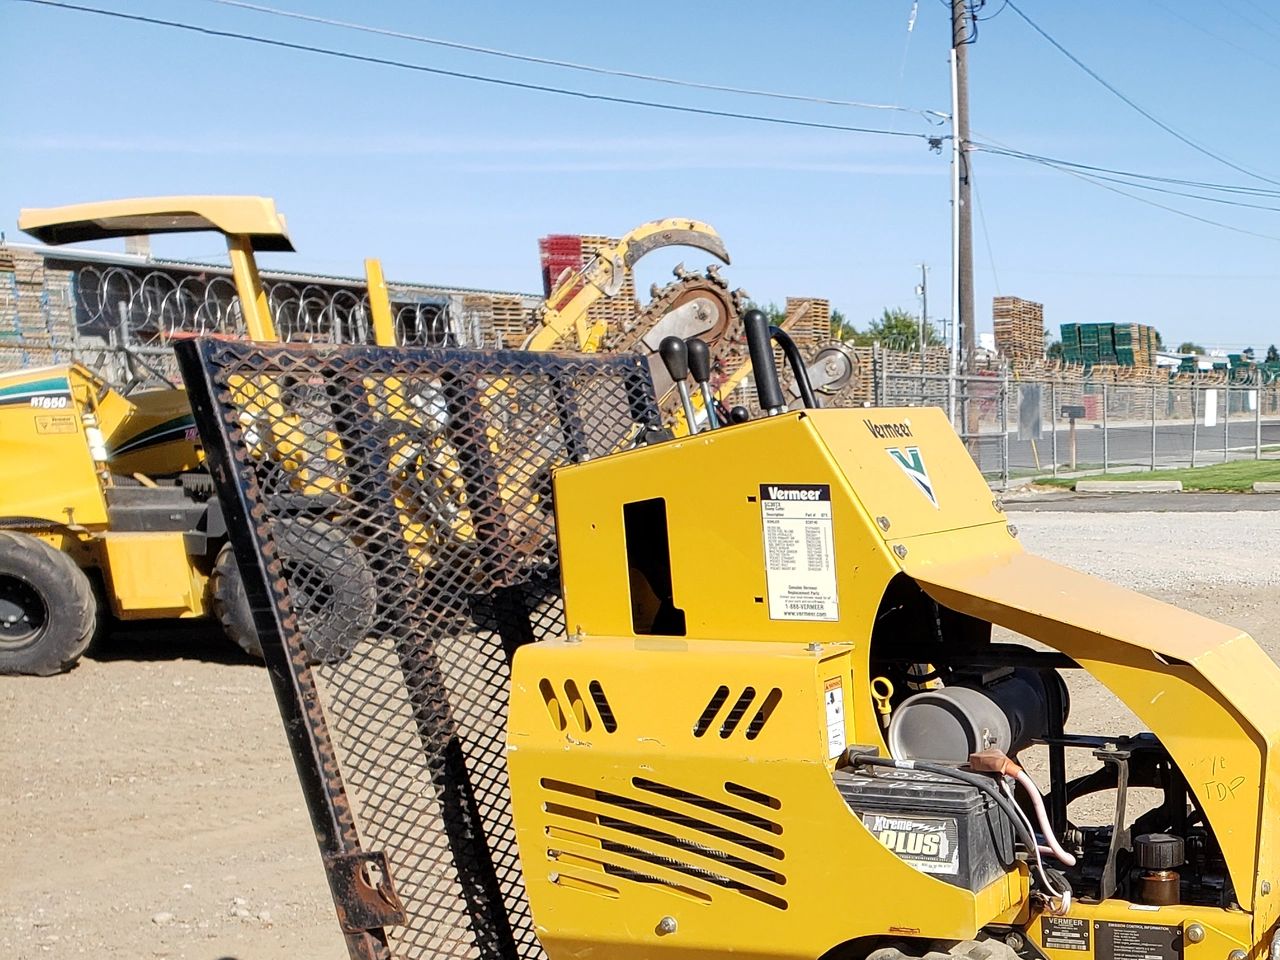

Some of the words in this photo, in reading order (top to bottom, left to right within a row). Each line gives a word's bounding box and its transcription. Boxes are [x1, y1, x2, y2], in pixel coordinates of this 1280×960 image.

[863, 419, 913, 438] Vermeer
[768, 486, 821, 500] Vermeer
[873, 815, 912, 832] Xtreme
[1048, 917, 1084, 927] VERMEER
